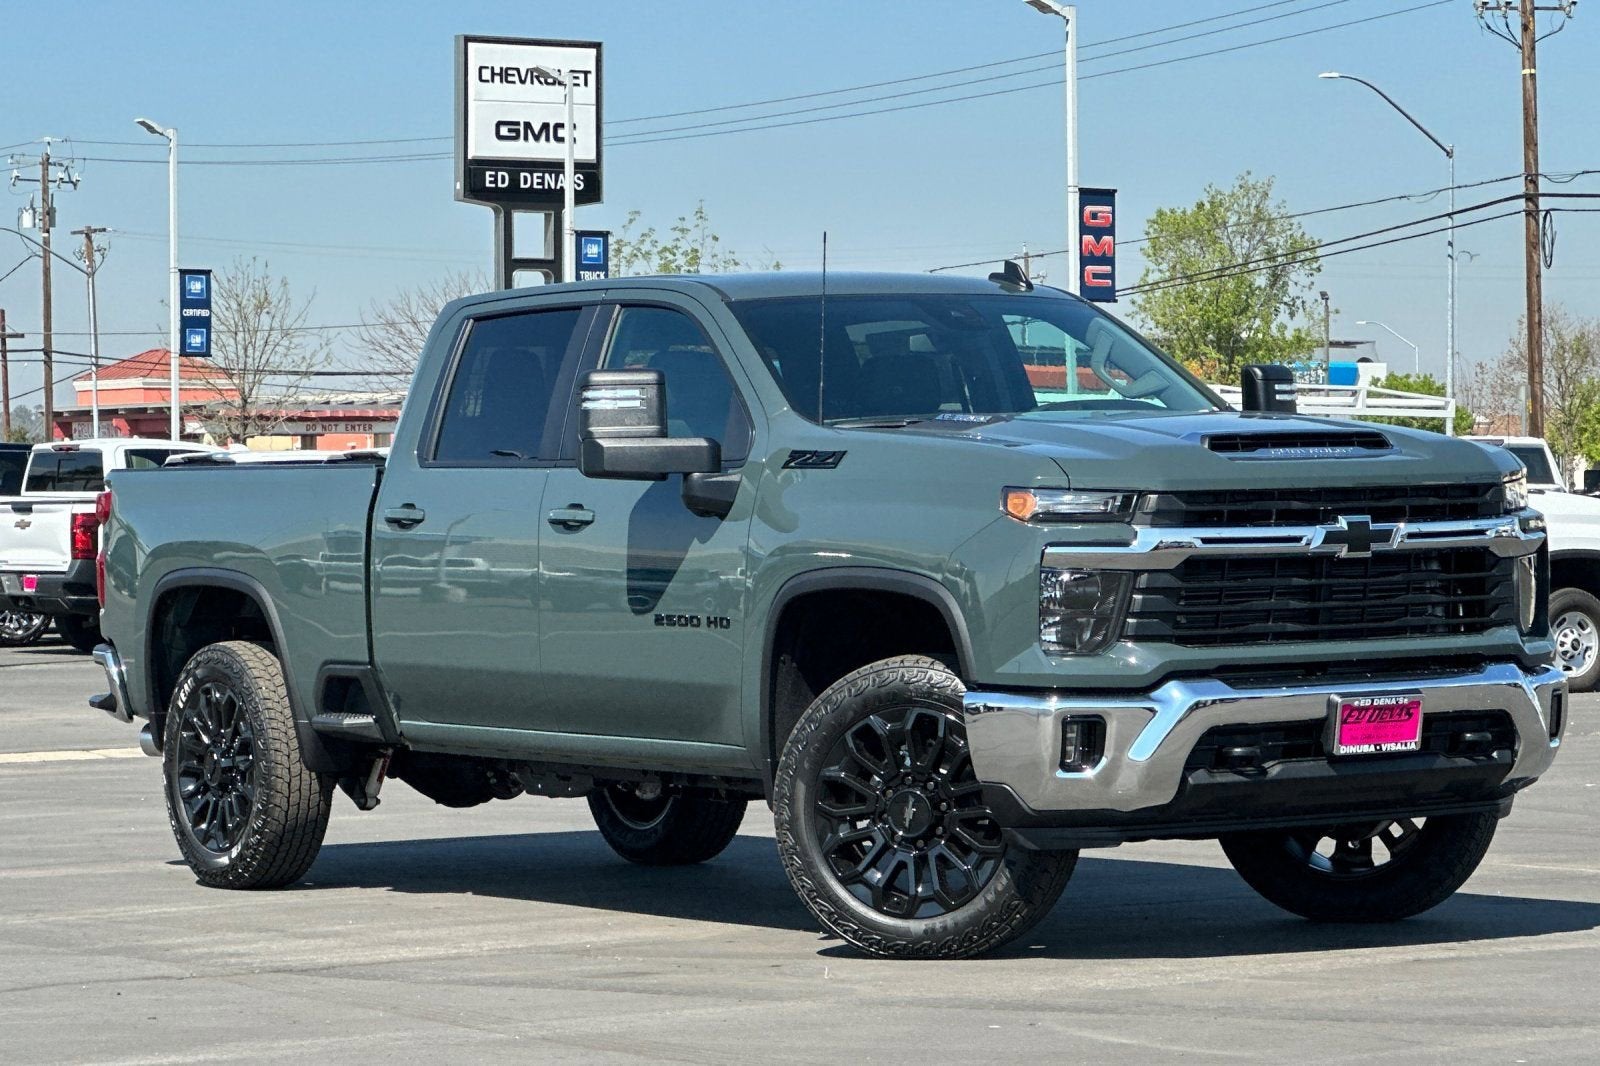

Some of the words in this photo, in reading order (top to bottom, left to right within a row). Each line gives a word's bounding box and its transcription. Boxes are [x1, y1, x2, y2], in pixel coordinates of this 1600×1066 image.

[495, 120, 577, 144] GMC
[485, 171, 509, 188] ED
[519, 172, 585, 190] DENAS
[587, 243, 598, 254] GM
[1082, 205, 1114, 287] GMC
[580, 271, 605, 281] TRUCK
[190, 280, 201, 290] GM
[182, 308, 210, 317] CERTIFIED
[190, 334, 201, 344] GM
[305, 423, 317, 432] DO
[322, 423, 338, 432] NOT
[345, 423, 373, 432] ENTER
[654, 614, 701, 628] 2500
[706, 615, 731, 629] HD
[1360, 698, 1371, 706] ED
[1373, 697, 1403, 706] DENA'S
[1340, 743, 1375, 754] DINUBA
[1381, 741, 1416, 752] VISALIA
